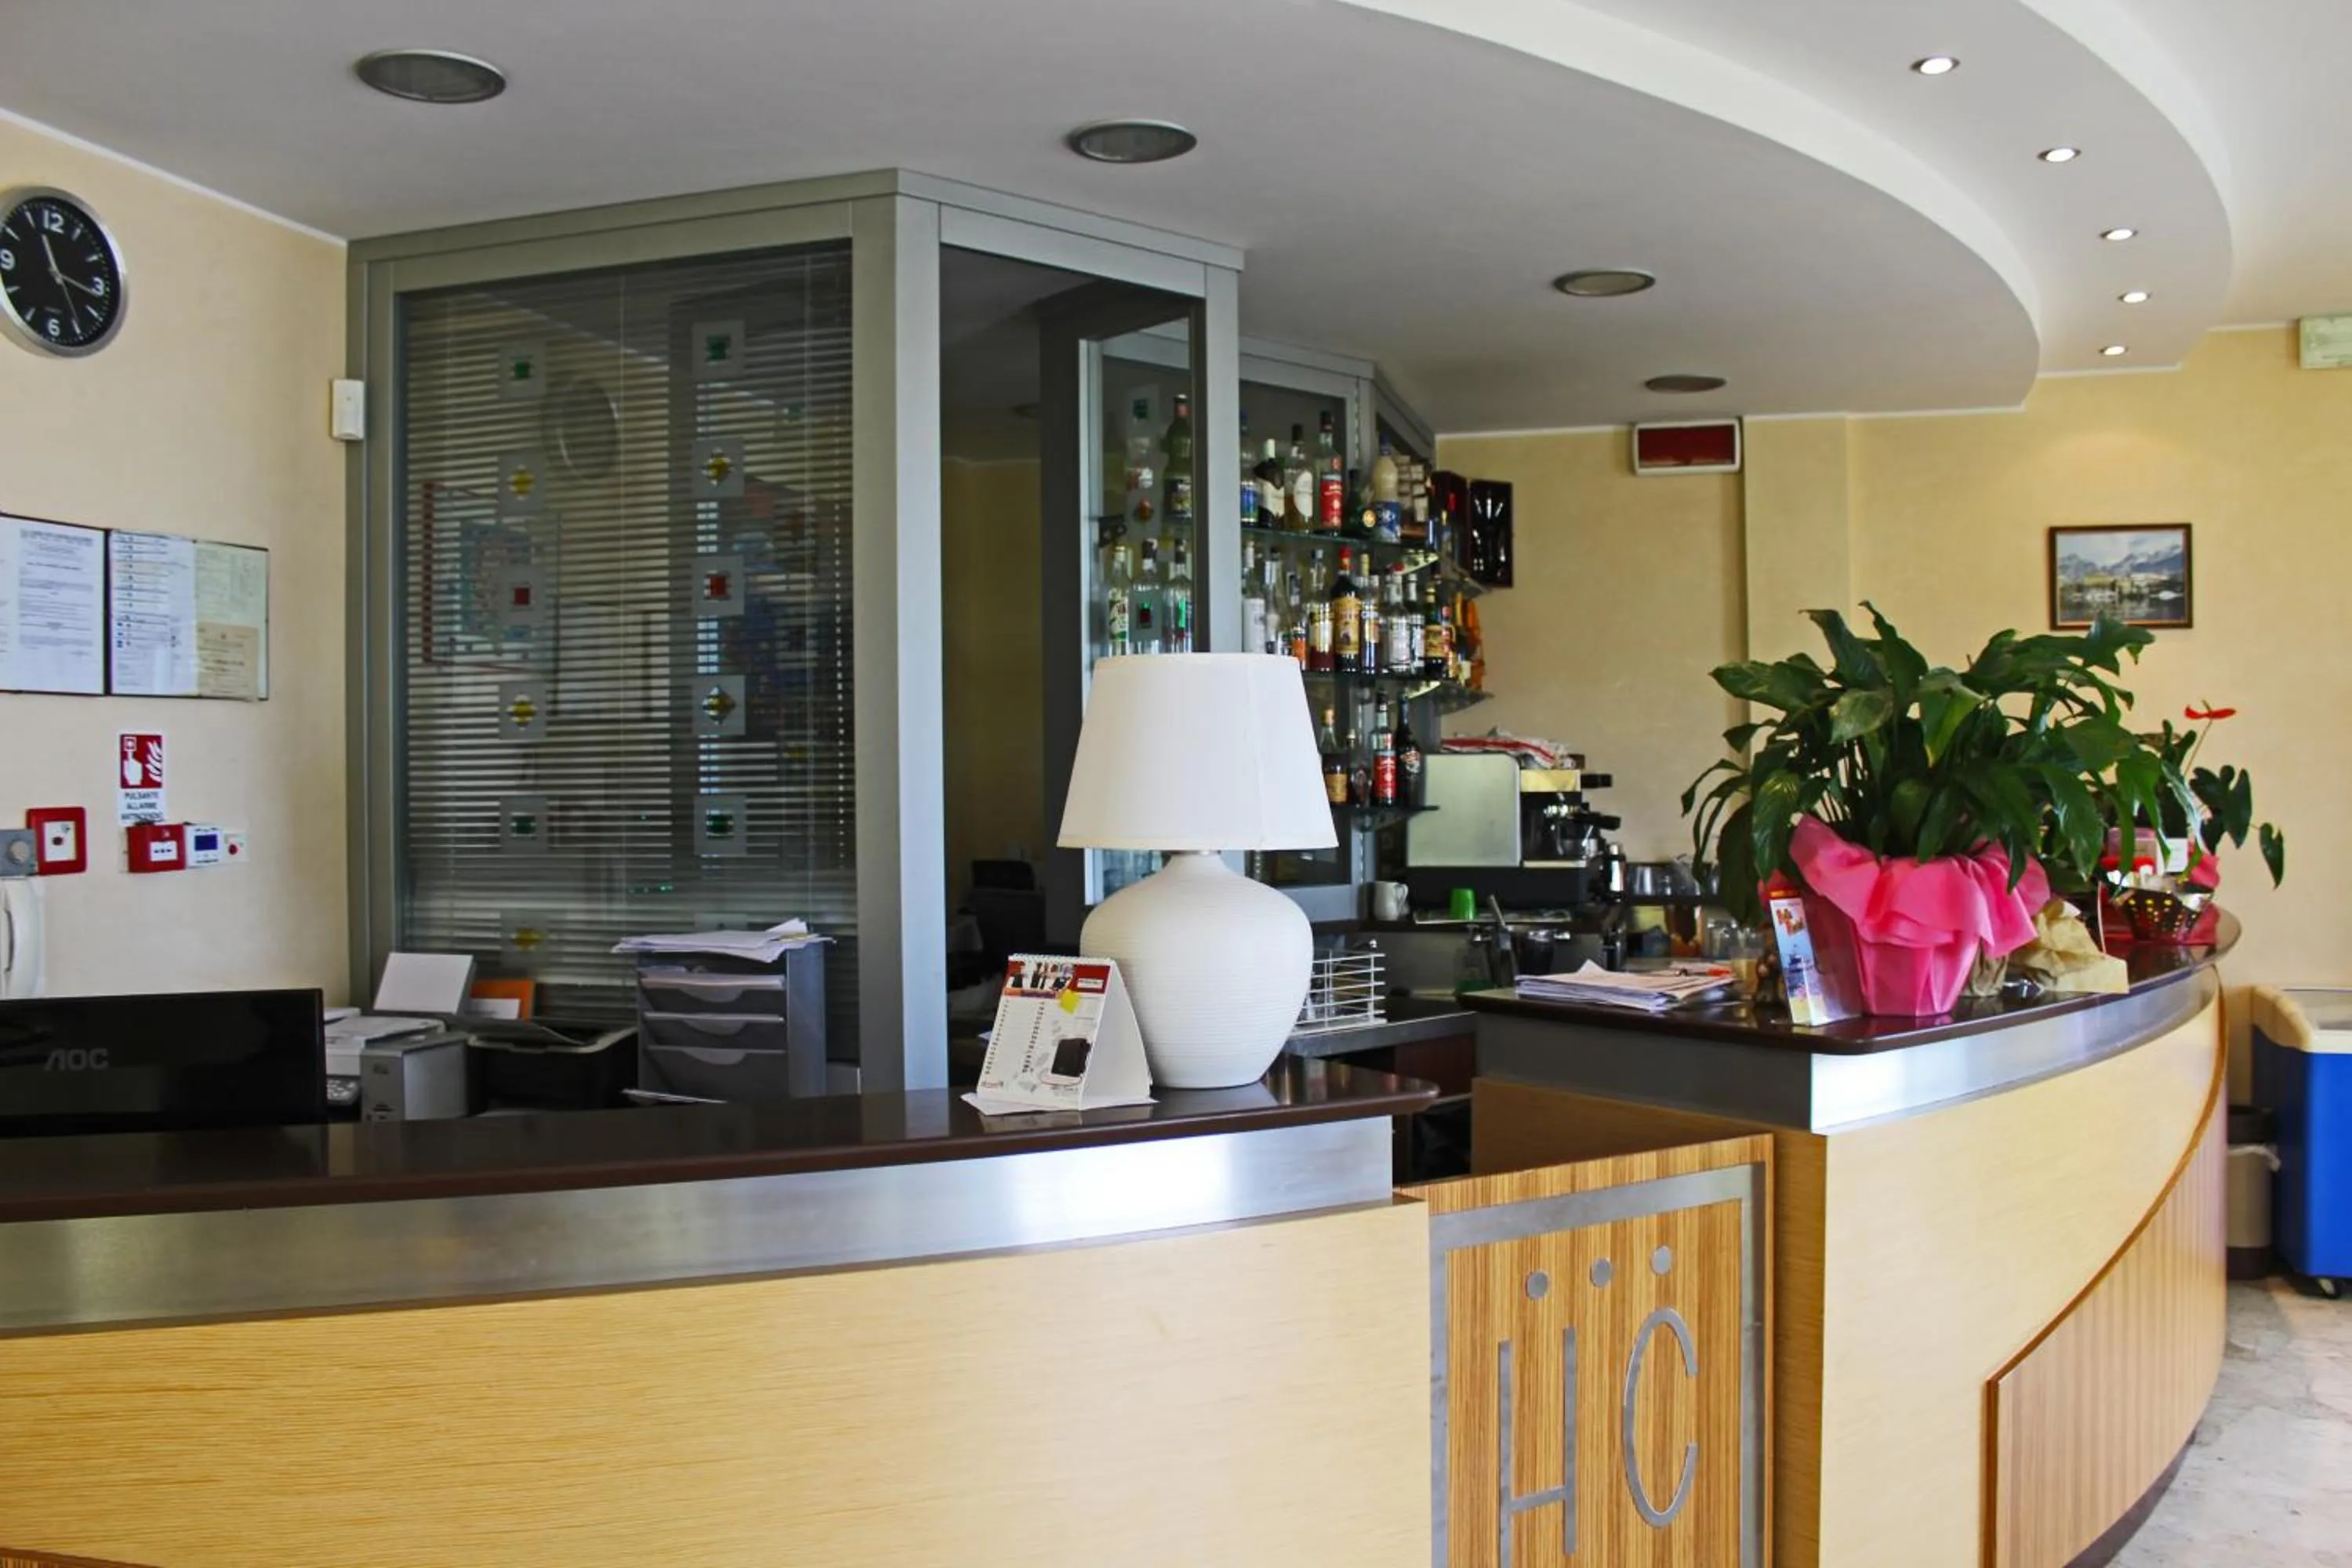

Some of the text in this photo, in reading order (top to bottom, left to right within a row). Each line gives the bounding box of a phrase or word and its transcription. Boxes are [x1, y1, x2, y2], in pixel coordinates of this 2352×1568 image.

[43, 209, 64, 234] 12
[0, 249, 15, 271] 9
[92, 277, 104, 296] 3
[48, 318, 60, 336] 6
[44, 1048, 108, 1072] AOC
